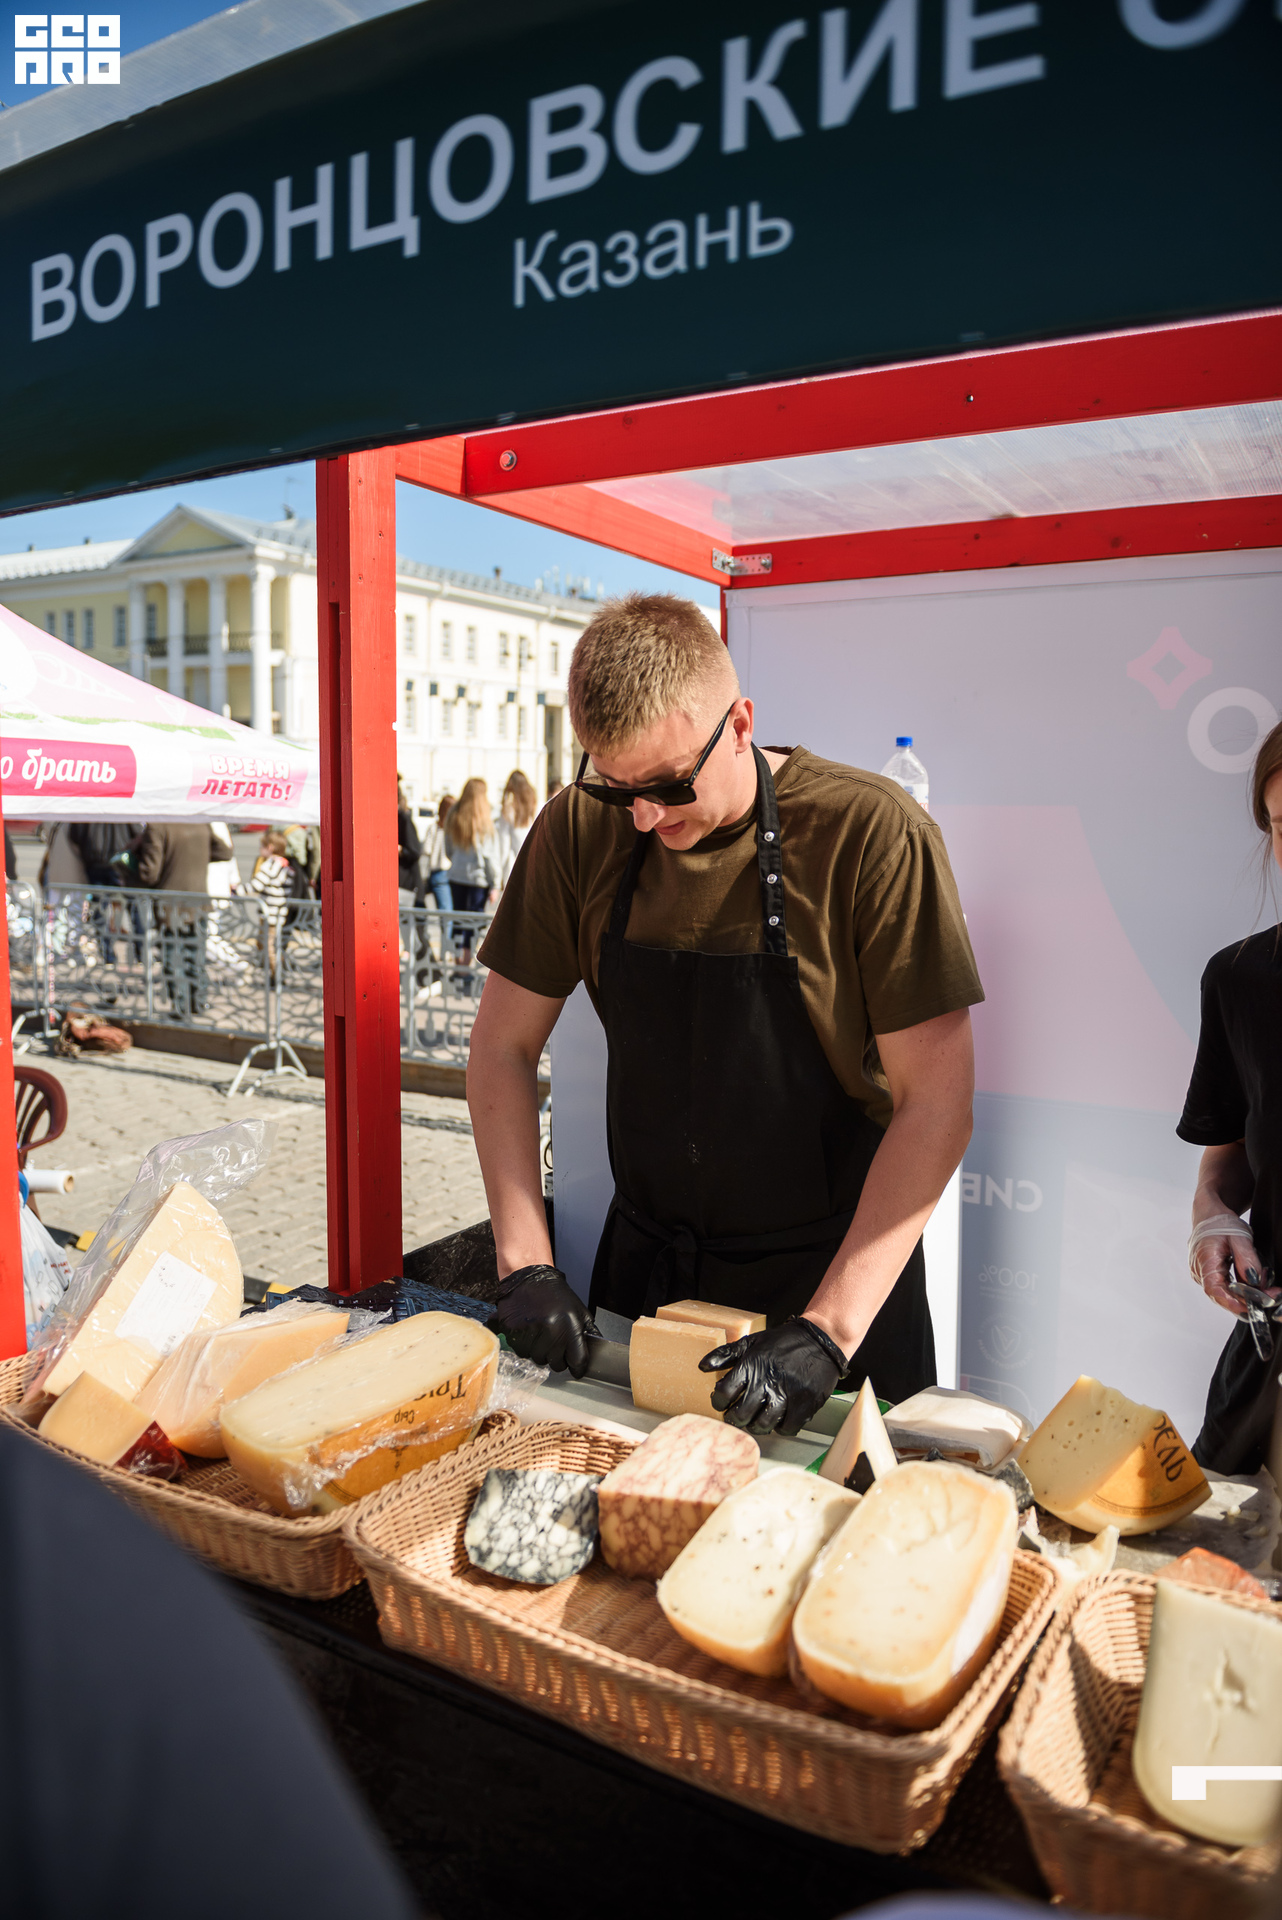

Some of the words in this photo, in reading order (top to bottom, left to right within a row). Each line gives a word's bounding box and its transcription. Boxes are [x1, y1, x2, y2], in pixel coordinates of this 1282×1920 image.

[31, 0, 1045, 343] ВОРОНЦОВСКИЕ
[514, 201, 794, 307] Казань
[22, 748, 116, 790] брать
[210, 755, 291, 780] ВРЕМЯ
[201, 779, 292, 801] ЛЕТАТЬ!
